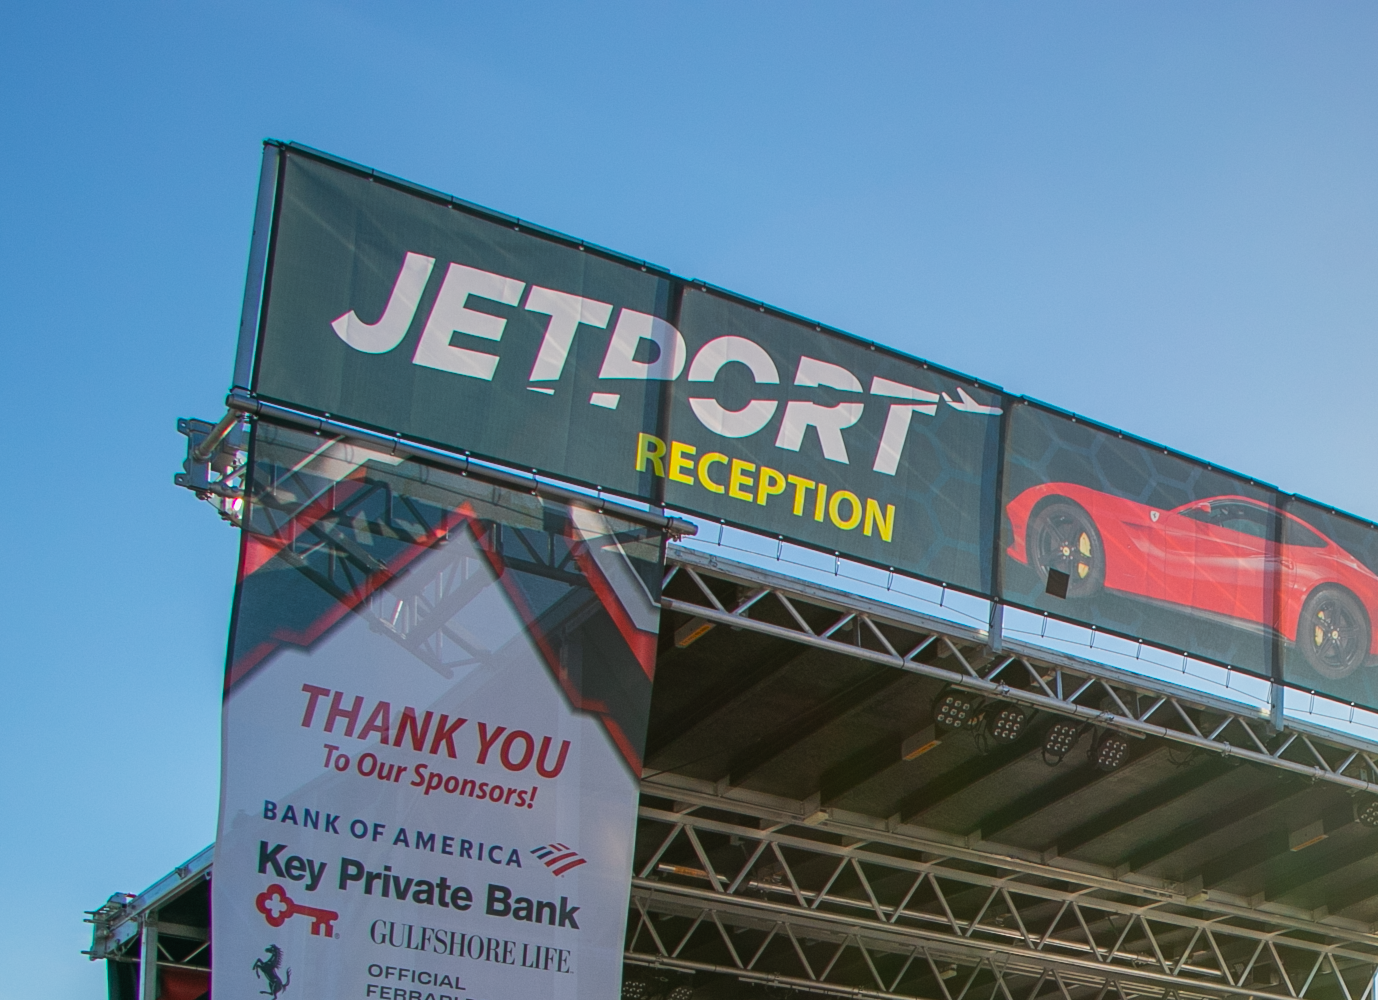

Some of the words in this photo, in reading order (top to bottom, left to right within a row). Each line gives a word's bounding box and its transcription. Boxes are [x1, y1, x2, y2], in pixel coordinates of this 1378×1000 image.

[331, 251, 940, 477] JETPORT
[636, 431, 897, 543] RECEPTION
[300, 683, 469, 760] THANK
[475, 721, 571, 779] YOU
[322, 743, 351, 772] To
[356, 752, 408, 783] Our
[410, 763, 538, 810] Sponsors!
[262, 800, 341, 835] BANK
[350, 819, 386, 842] OF
[392, 827, 523, 868] AMERICA
[257, 840, 328, 892] Key
[338, 856, 474, 911] Private
[484, 883, 581, 930] Bank
[367, 963, 467, 991] OFFICIAL
[369, 918, 516, 966] GULFSHORE
